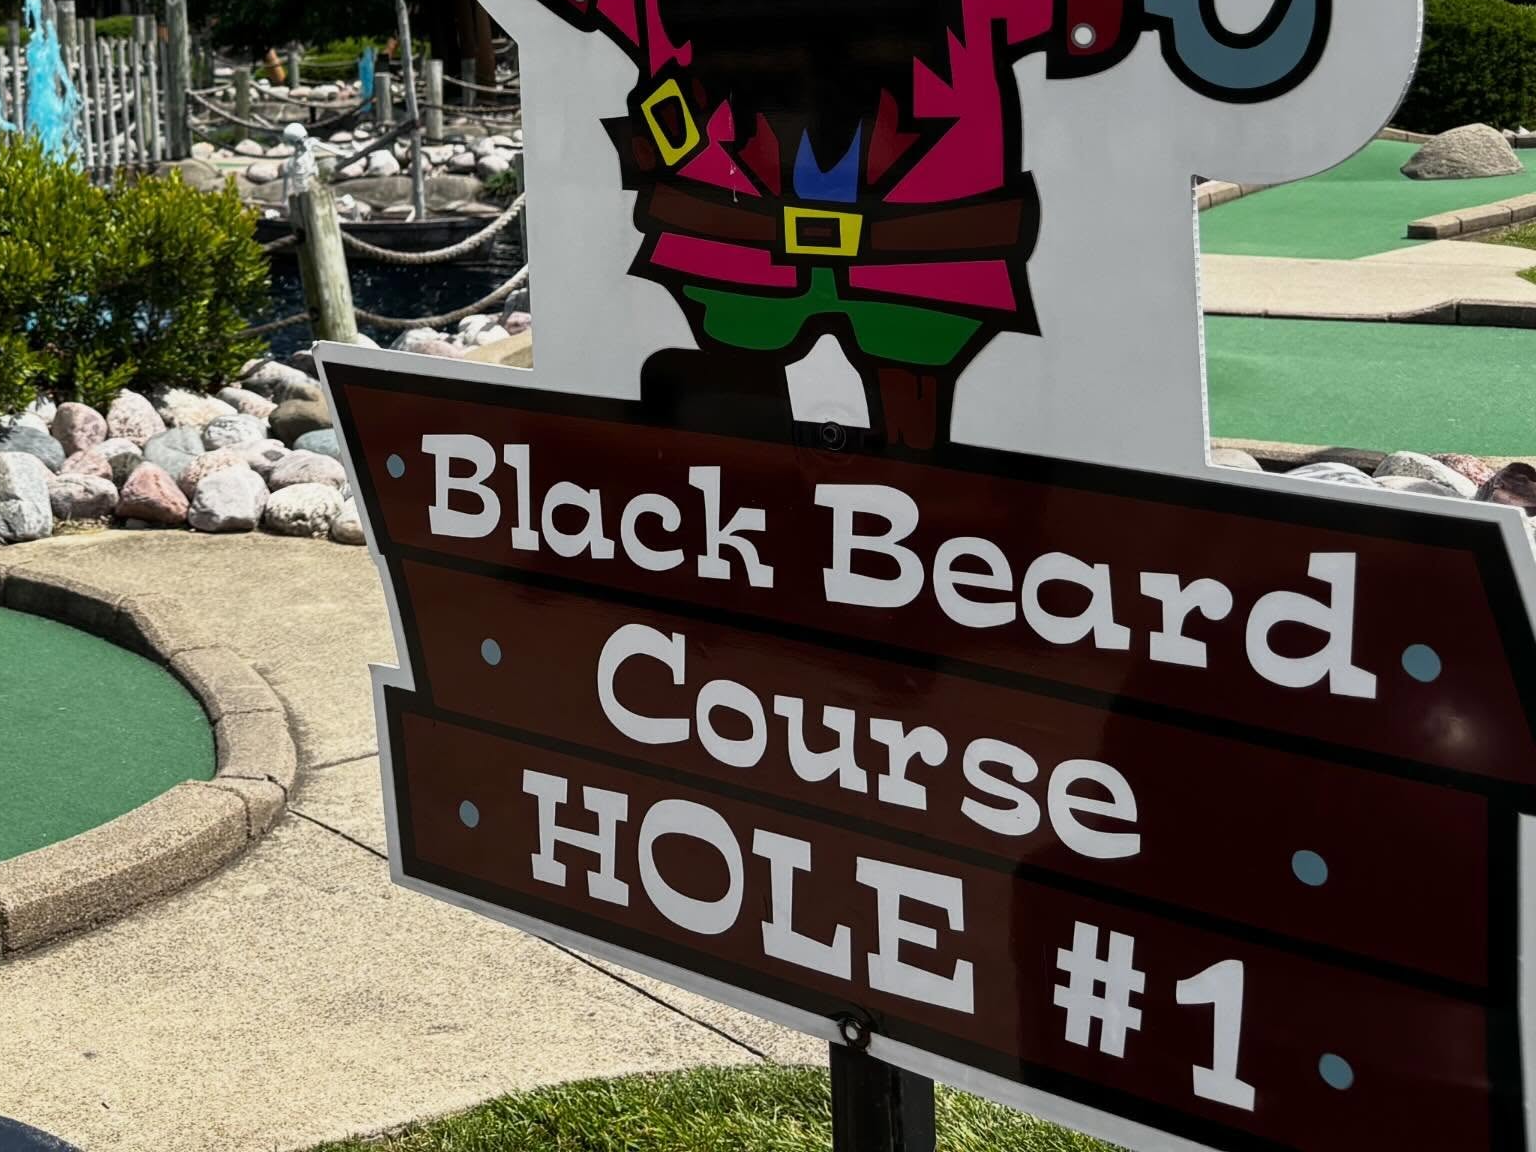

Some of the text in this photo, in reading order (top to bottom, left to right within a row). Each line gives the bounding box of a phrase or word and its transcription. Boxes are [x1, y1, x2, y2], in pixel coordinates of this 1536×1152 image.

[420, 433, 1377, 699] Black Beard
[597, 623, 1141, 859] Course
[522, 769, 1255, 1112] HOLE #1
